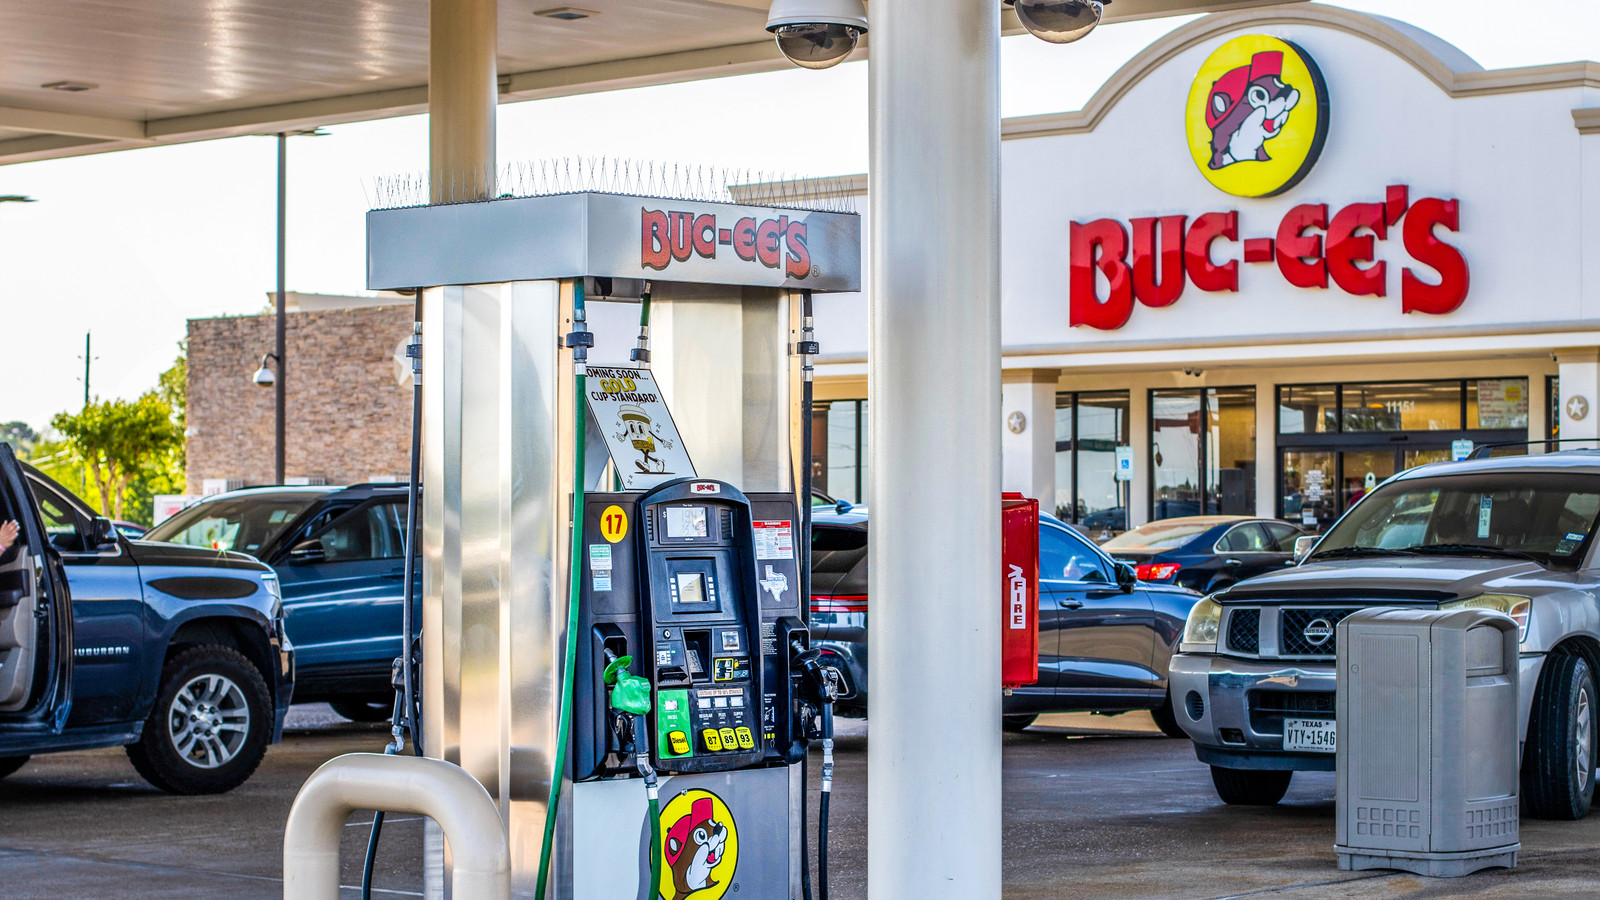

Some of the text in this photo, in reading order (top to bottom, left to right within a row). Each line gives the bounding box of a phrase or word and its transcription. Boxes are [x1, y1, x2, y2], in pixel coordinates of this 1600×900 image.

[641, 206, 811, 280] BUC-EE'S
[1069, 184, 1470, 331] BUC-EE'S
[600, 377, 637, 394] GOLD
[591, 391, 659, 403] CUP STANDARD!
[1385, 400, 1415, 414] 11151
[605, 514, 623, 535] 17
[1013, 581, 1023, 625] FIRE
[1302, 720, 1323, 728] TEXAS
[707, 736, 717, 745] 87
[723, 735, 734, 744] 89
[740, 733, 750, 743] 93
[1287, 729, 1336, 746] VTY 1546
